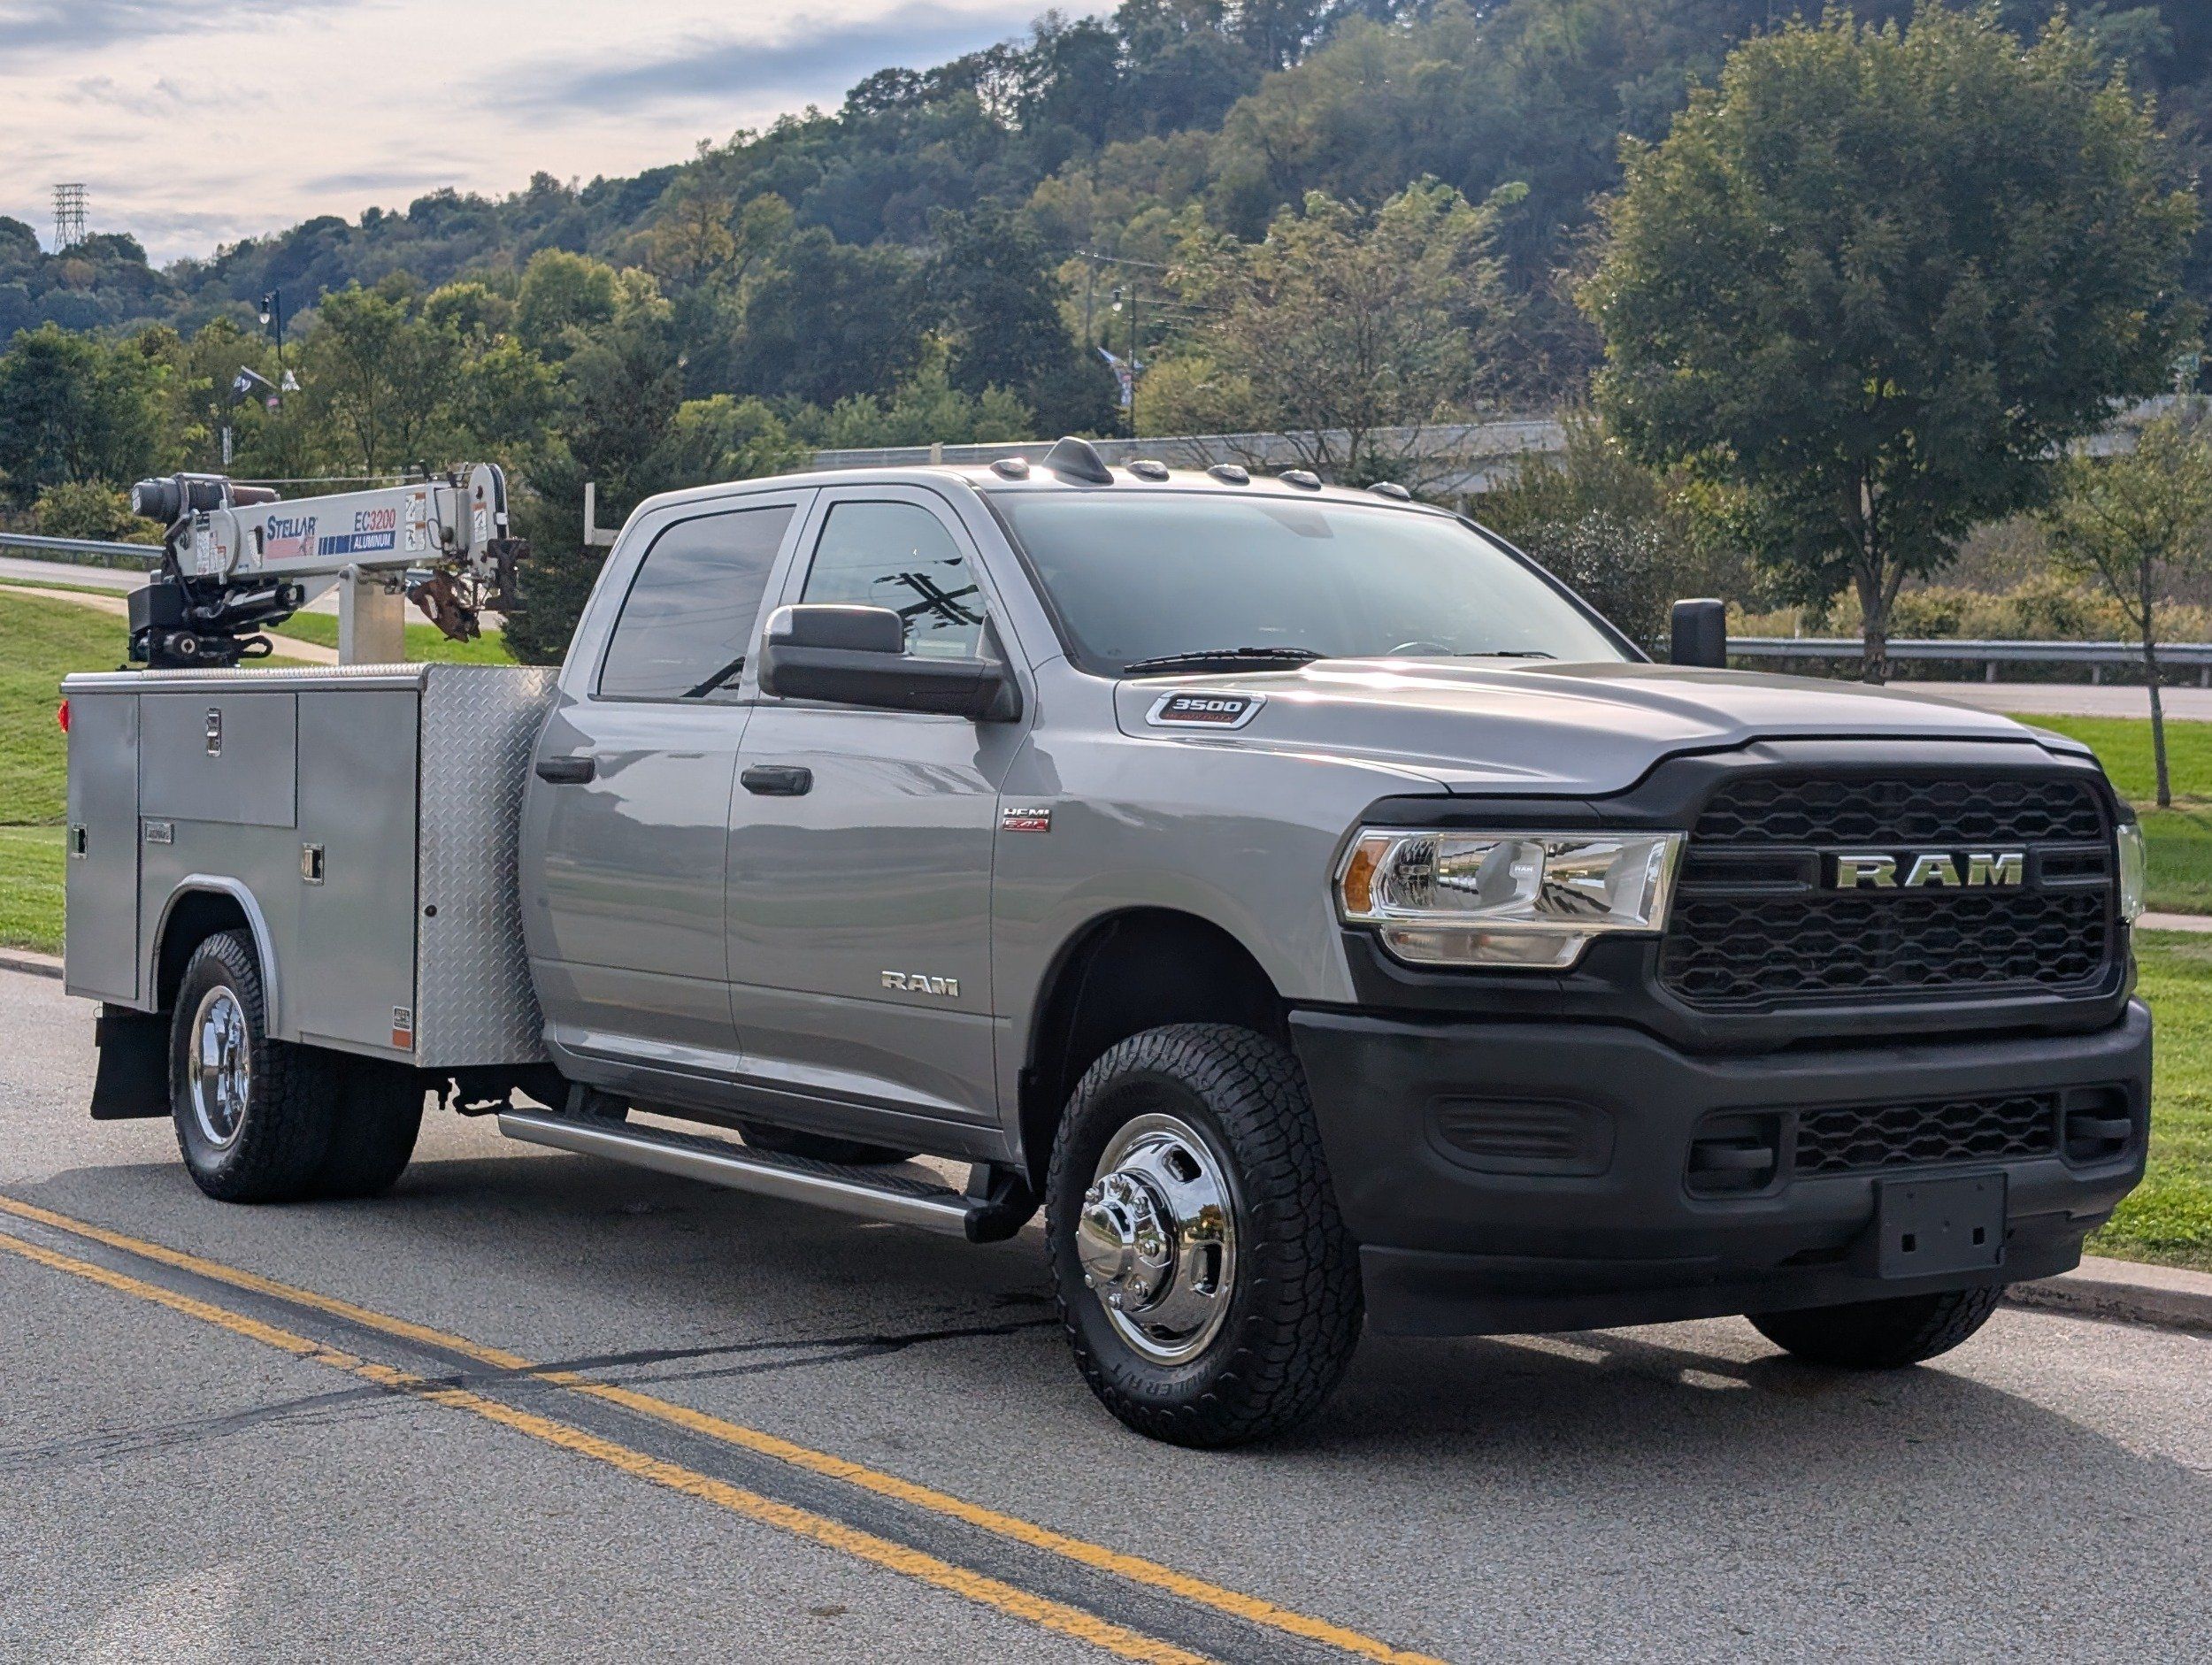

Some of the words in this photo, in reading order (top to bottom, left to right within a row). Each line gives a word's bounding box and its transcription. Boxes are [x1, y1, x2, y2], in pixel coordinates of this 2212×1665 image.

[267, 515, 317, 541] STELLAR
[355, 508, 396, 533] EC3200
[354, 533, 391, 549] ALUMINUM
[1172, 698, 1243, 712] 3500
[1003, 807, 1050, 817] HEMI
[1837, 852, 2024, 888] RAM
[880, 970, 960, 997] RAM
